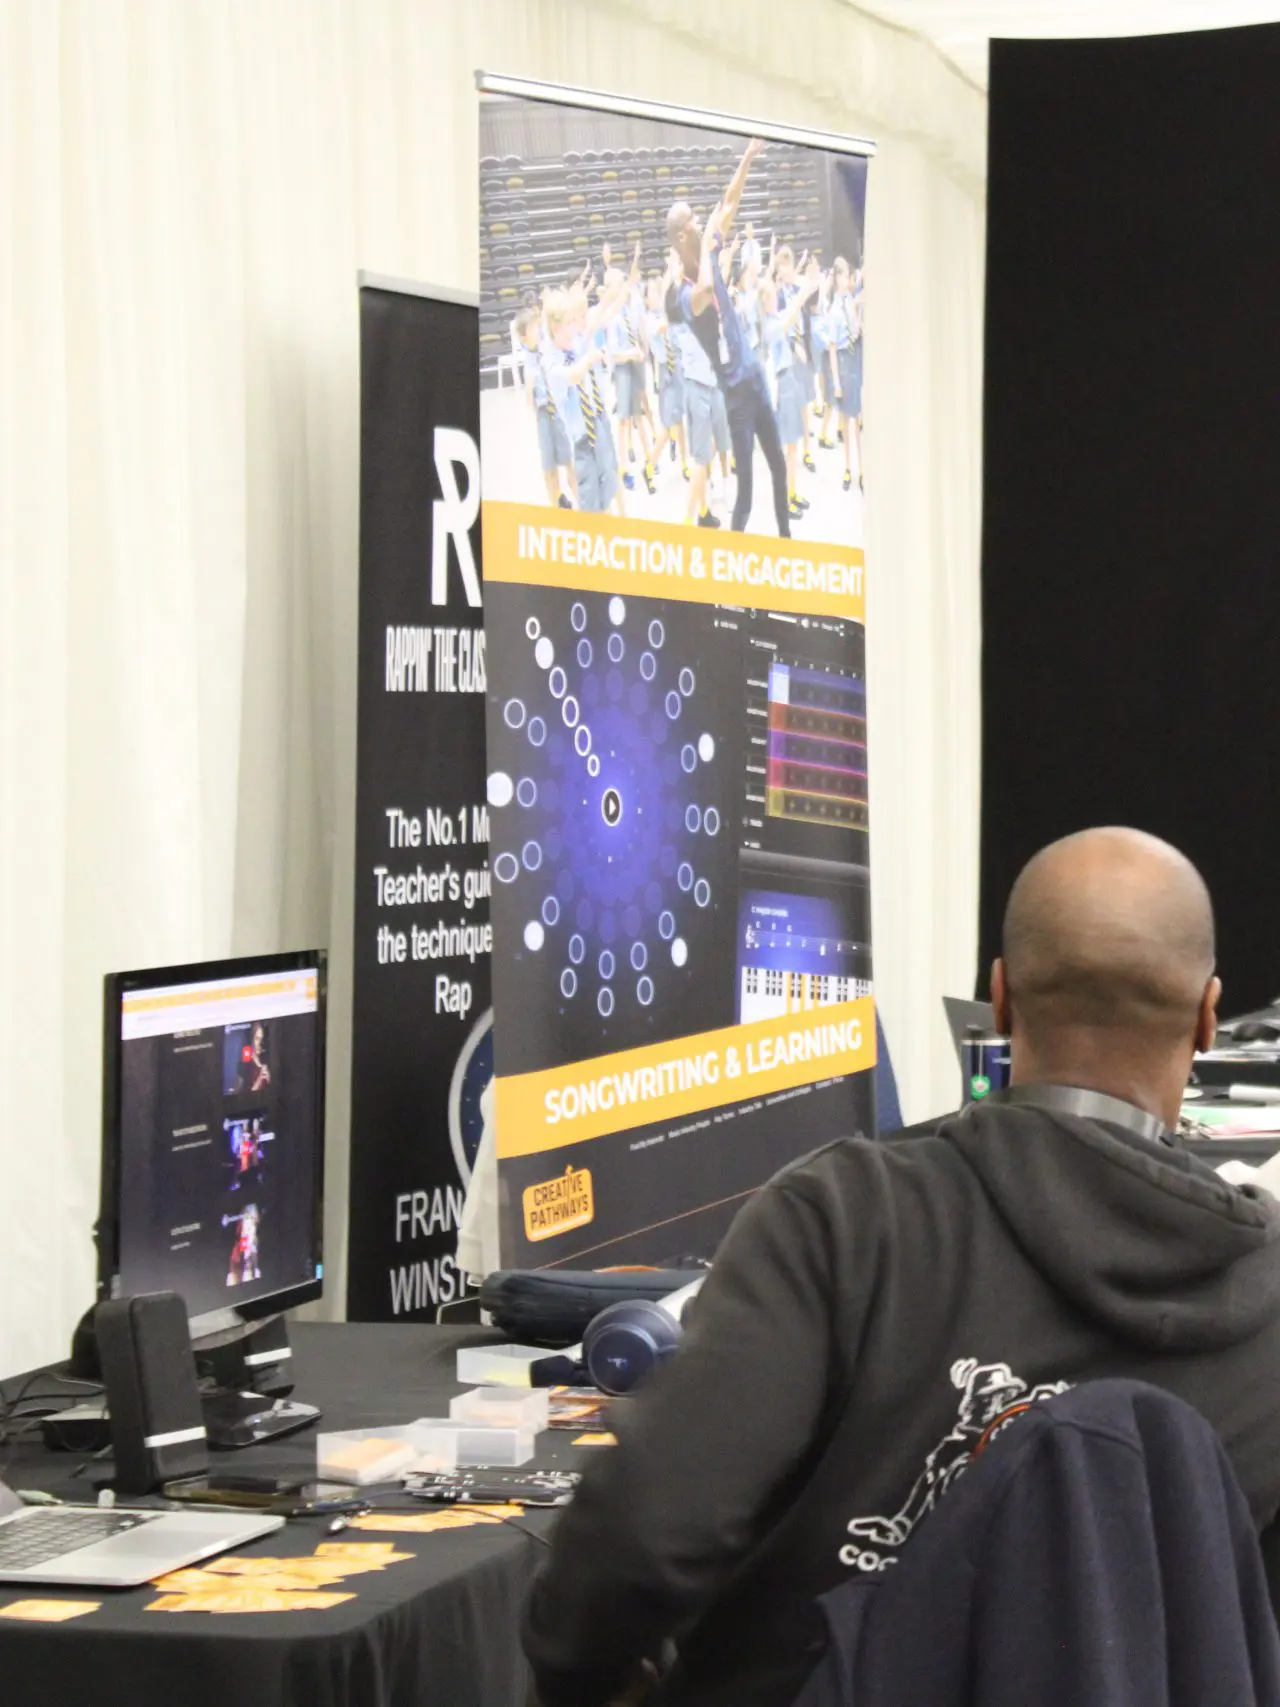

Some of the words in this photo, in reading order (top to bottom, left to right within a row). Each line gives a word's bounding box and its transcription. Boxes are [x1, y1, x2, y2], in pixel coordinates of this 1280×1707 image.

[518, 525, 683, 577] INTERACTION
[689, 546, 706, 578] &
[712, 548, 864, 597] ENGAGEMENT
[385, 624, 432, 692] RAPPIN'
[434, 628, 458, 692] THE
[385, 808, 421, 847] The
[373, 861, 460, 906] Teacher's
[377, 924, 407, 964] the
[411, 917, 493, 964] technique
[434, 974, 472, 1021] Rap
[544, 1051, 719, 1124] SONGWRITING
[725, 1046, 743, 1078] &
[746, 1019, 862, 1075] LEARNING
[530, 1193, 588, 1231] PATHWAYS
[533, 1173, 583, 1207] CREATIVE
